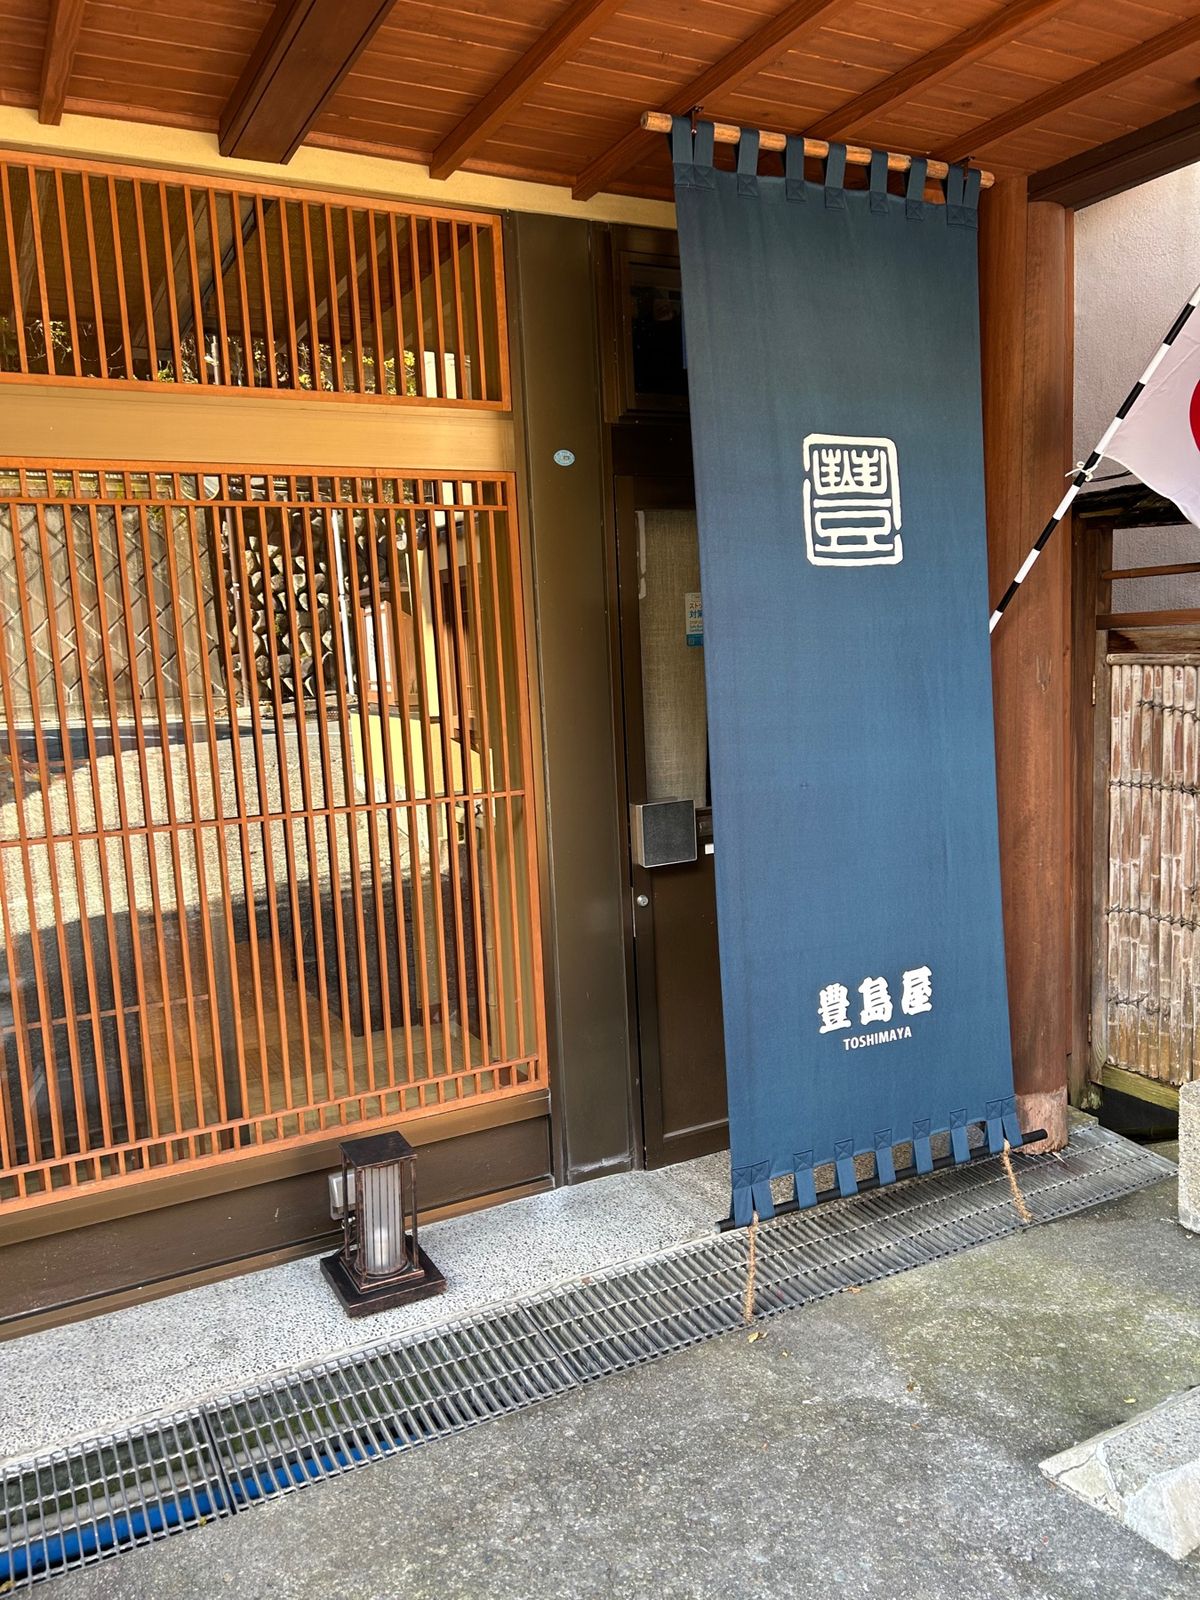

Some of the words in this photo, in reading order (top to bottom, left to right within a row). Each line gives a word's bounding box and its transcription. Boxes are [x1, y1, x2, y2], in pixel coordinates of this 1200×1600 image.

[817, 965, 933, 1034] 豊島屋
[843, 1026, 912, 1051] TOSHIMAYA
